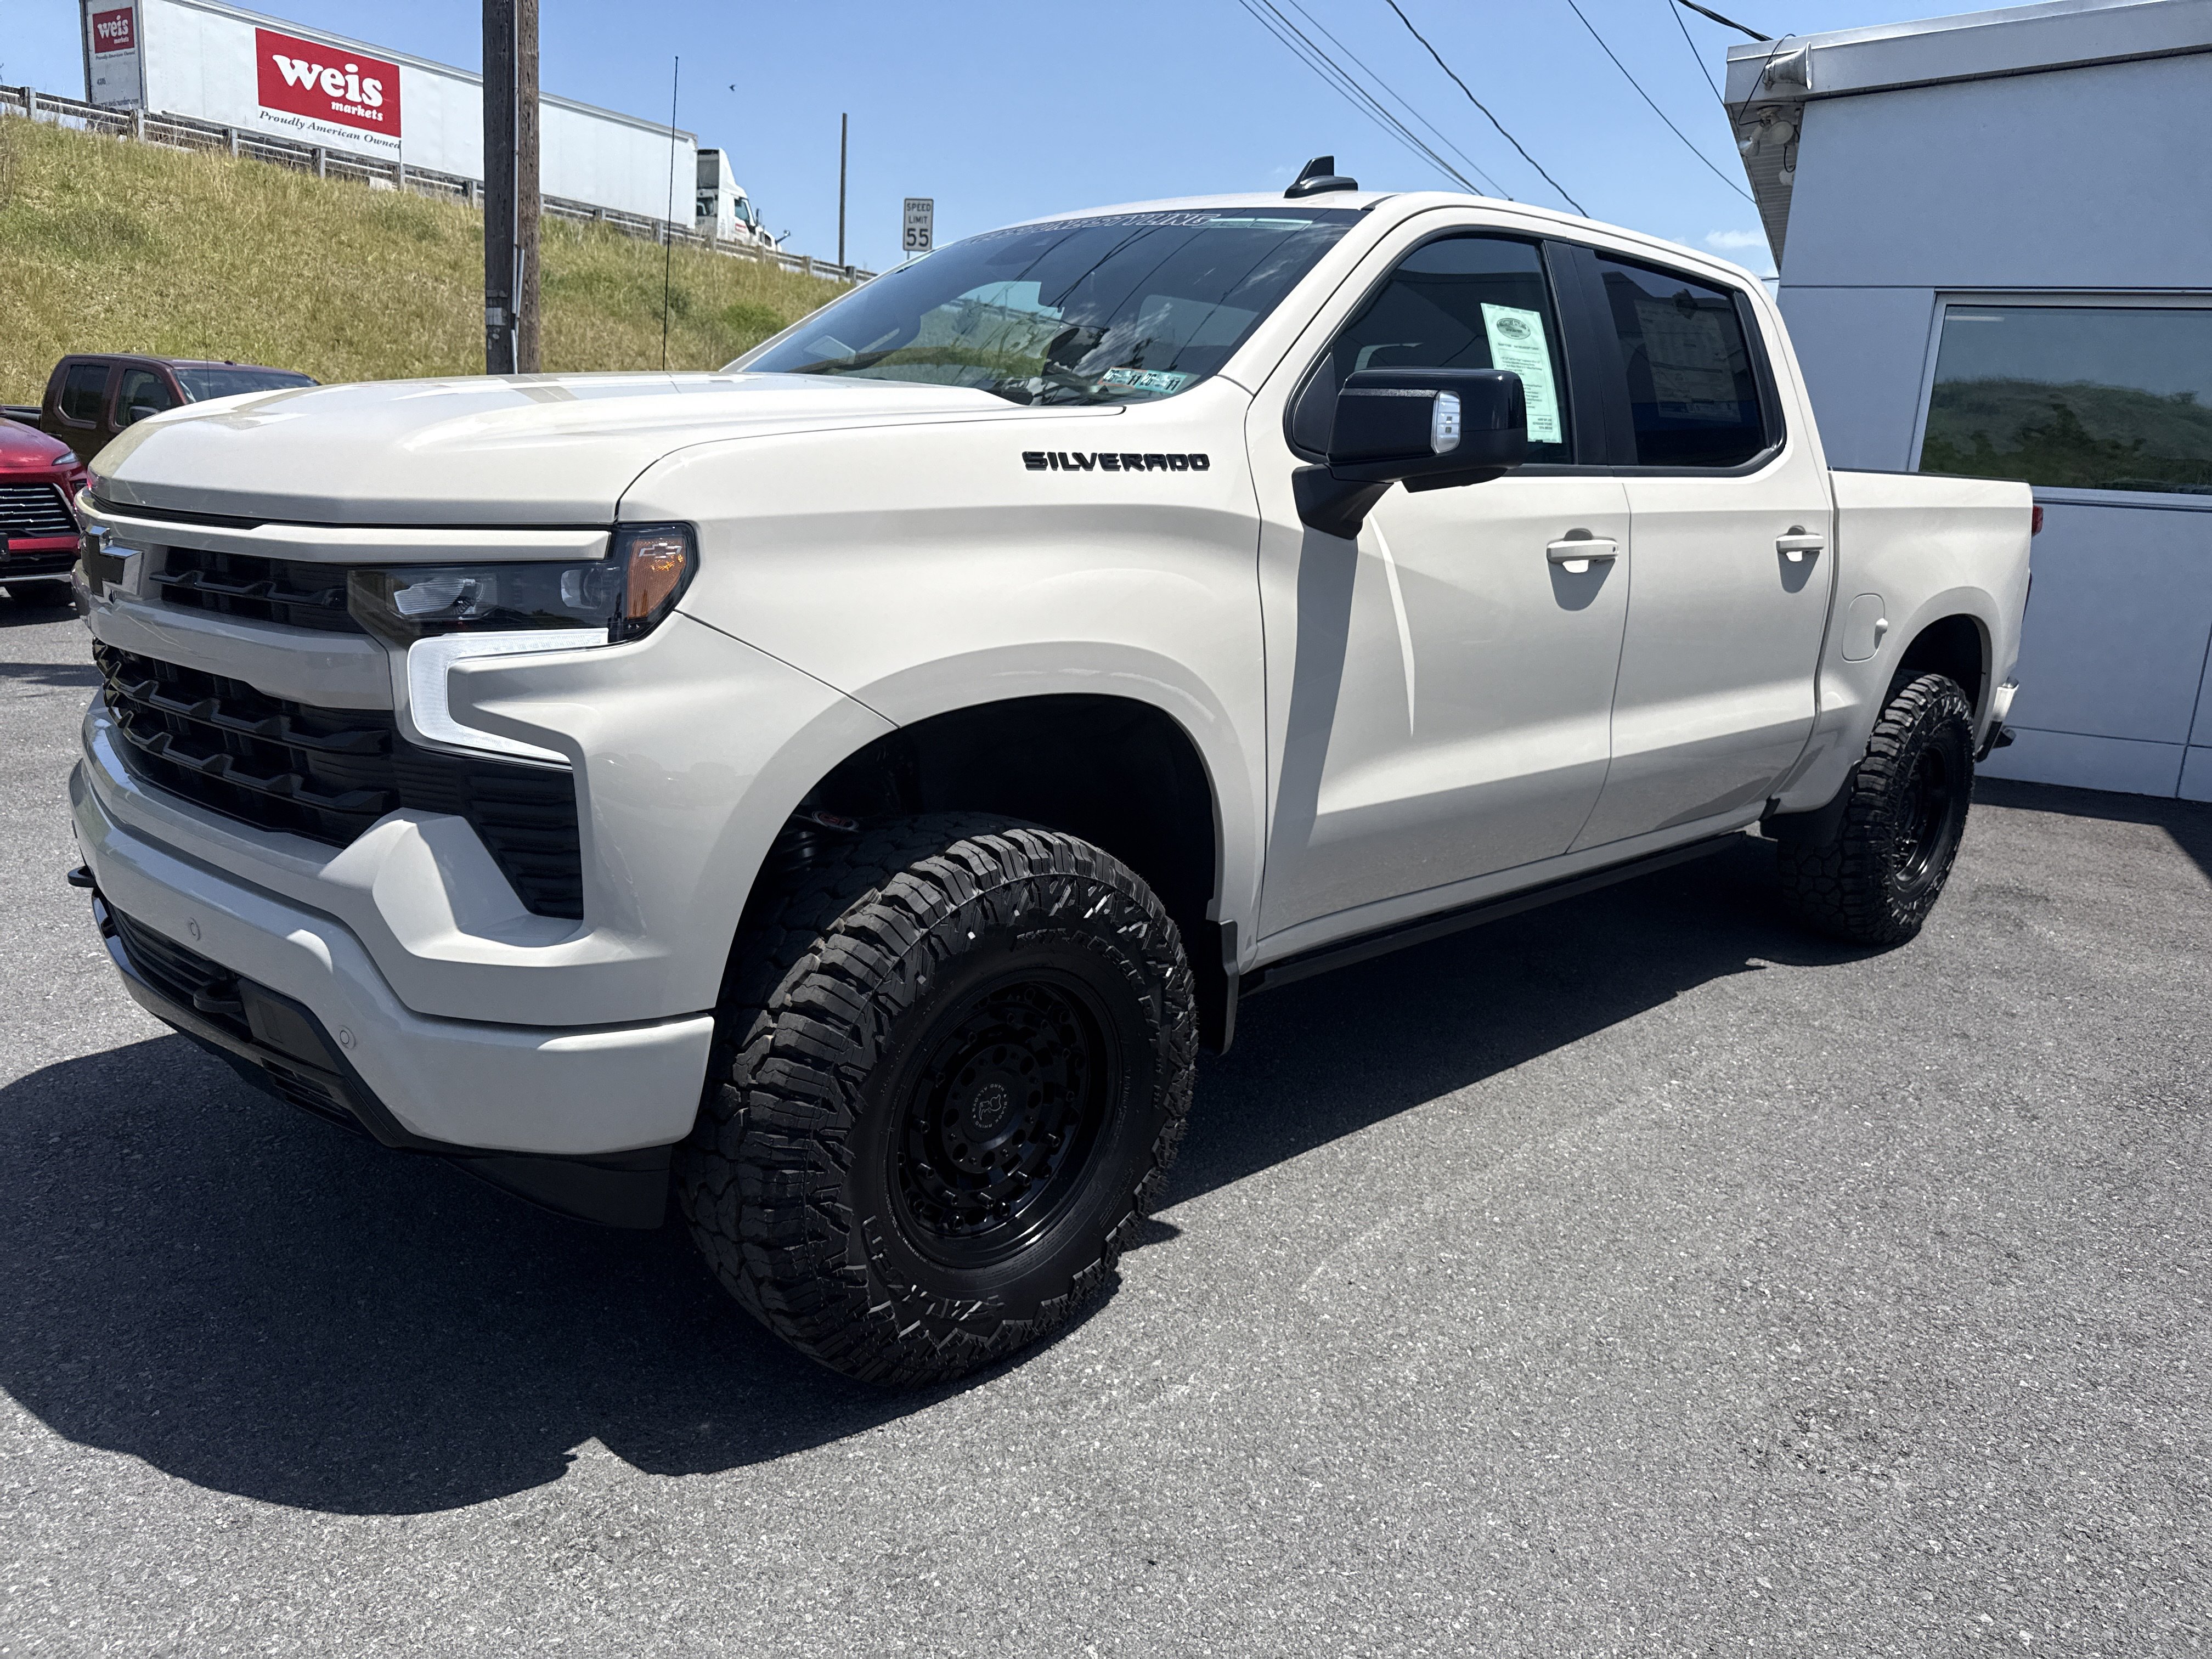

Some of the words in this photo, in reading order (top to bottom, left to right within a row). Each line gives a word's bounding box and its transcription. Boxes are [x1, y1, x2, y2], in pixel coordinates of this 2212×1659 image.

[97, 15, 128, 39] weis
[272, 54, 383, 107] weis
[331, 101, 383, 121] markets
[259, 111, 306, 129] Proudly
[307, 122, 360, 140] American
[364, 134, 401, 149] Owned
[907, 203, 931, 211] SPEED
[909, 216, 928, 224] LIMIT
[906, 228, 929, 247] 55
[1022, 451, 1210, 472] SILVERADO
[990, 1084, 1005, 1092] HARD
[972, 1086, 988, 1113] ALLOYS
[995, 1101, 1008, 1124] BLACK
[975, 1120, 992, 1128] RHINO
